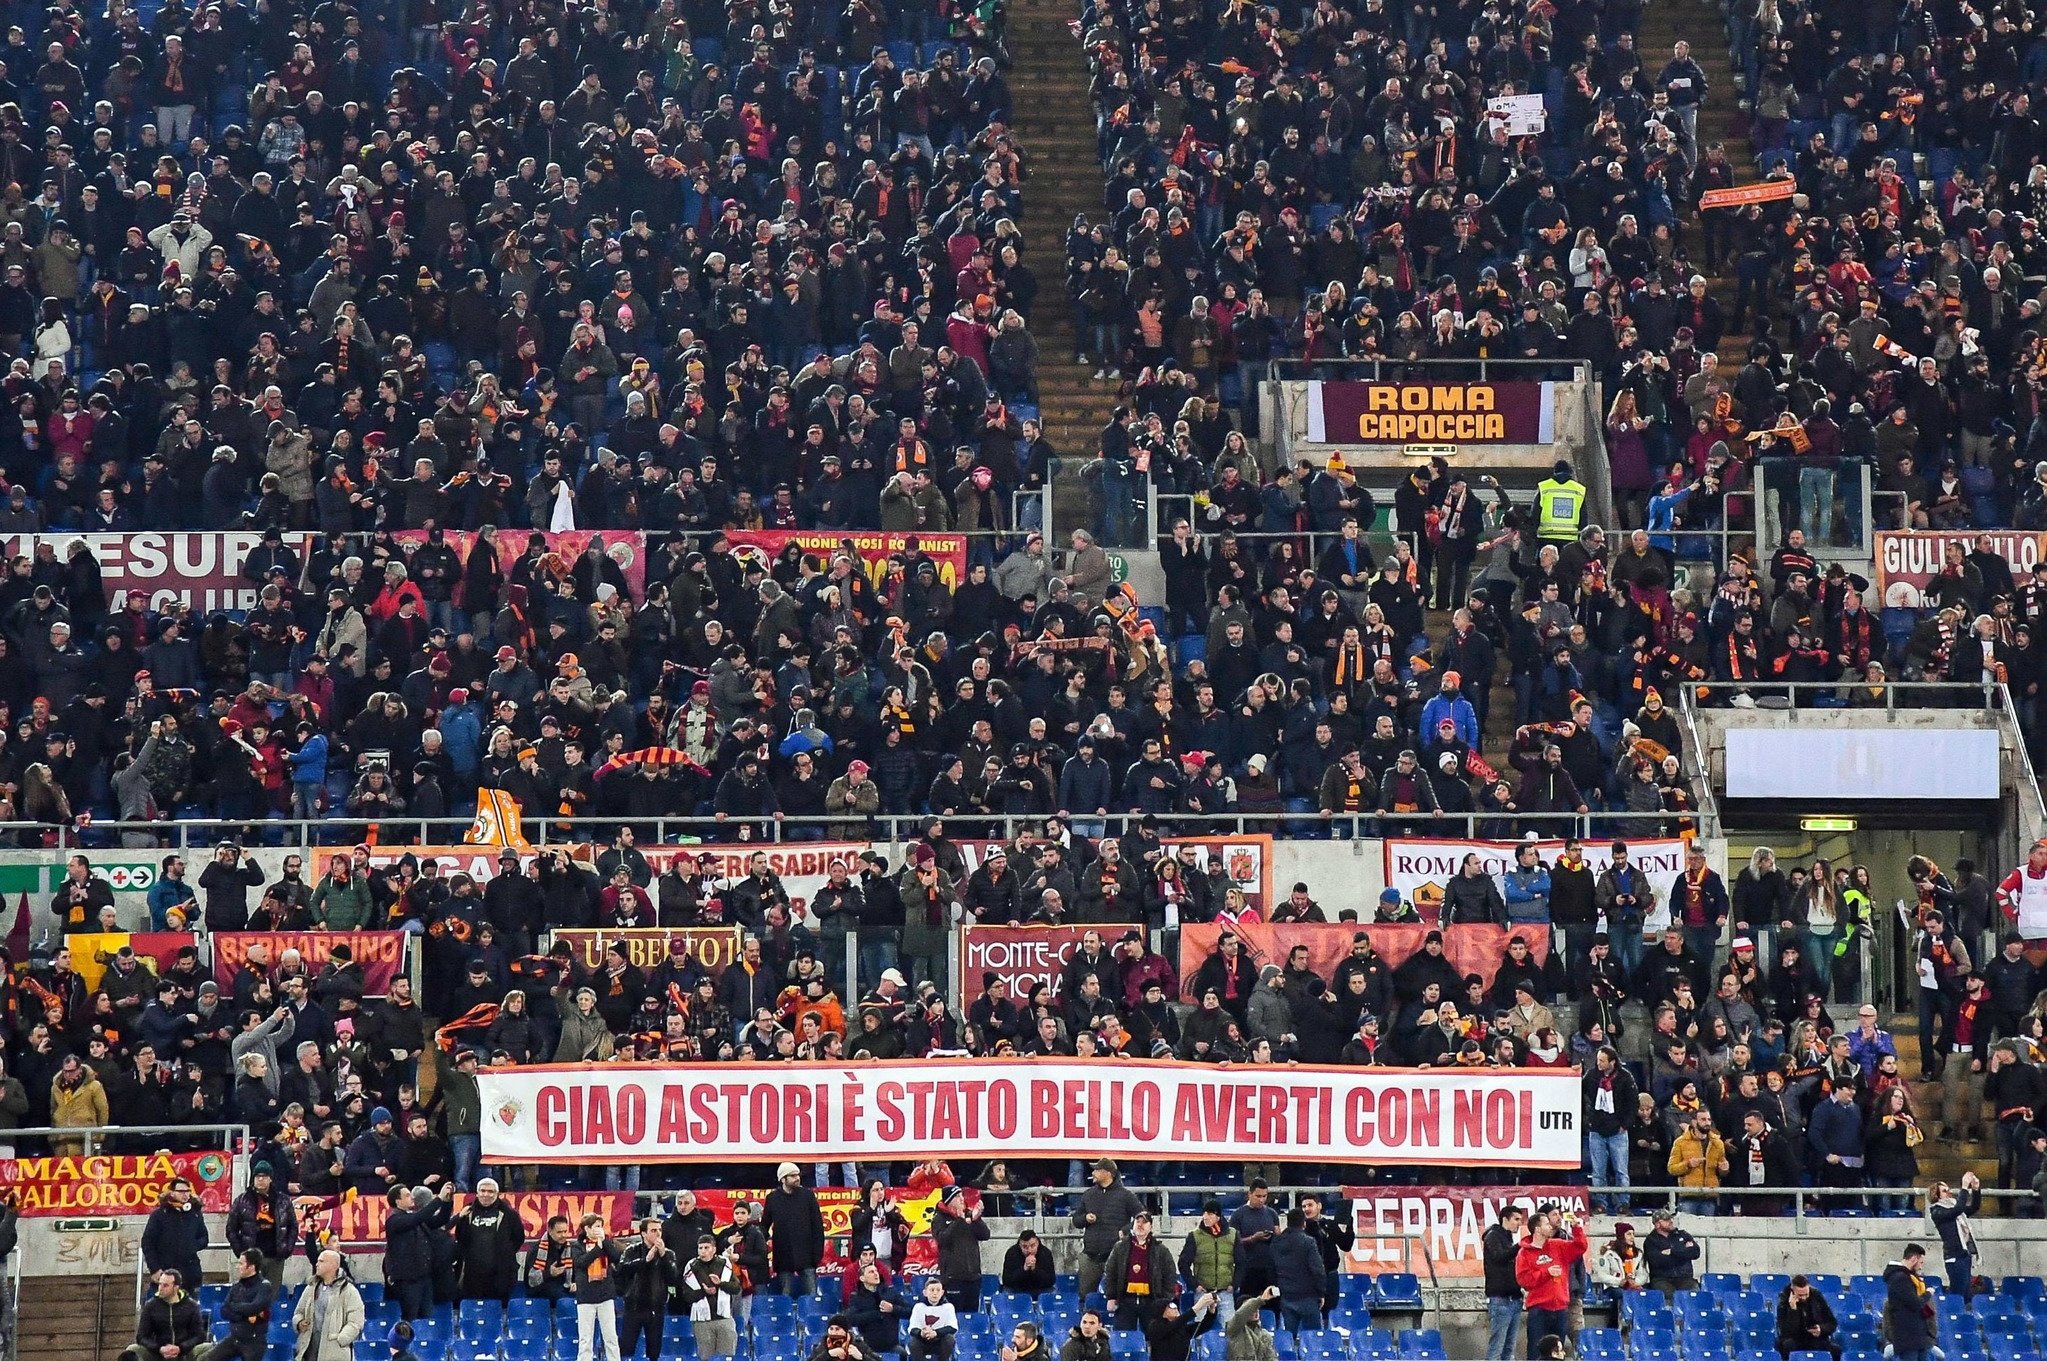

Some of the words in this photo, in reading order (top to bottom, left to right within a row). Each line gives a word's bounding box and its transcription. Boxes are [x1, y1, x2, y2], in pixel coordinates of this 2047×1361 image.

[1368, 386, 1495, 411] ROMA
[1359, 413, 1504, 439] CAPOCCIA
[537, 1084, 647, 1146] CIAO
[657, 1083, 829, 1144] ASTORI
[842, 1071, 865, 1142] È
[876, 1079, 1017, 1141] STATO
[1031, 1079, 1160, 1141] BELLO
[1171, 1083, 1333, 1145] AVERTI
[1345, 1087, 1440, 1147] CON
[1453, 1089, 1533, 1149] NOI
[1539, 1110, 1573, 1130] UTR
[16, 1154, 177, 1182] MAGLIA
